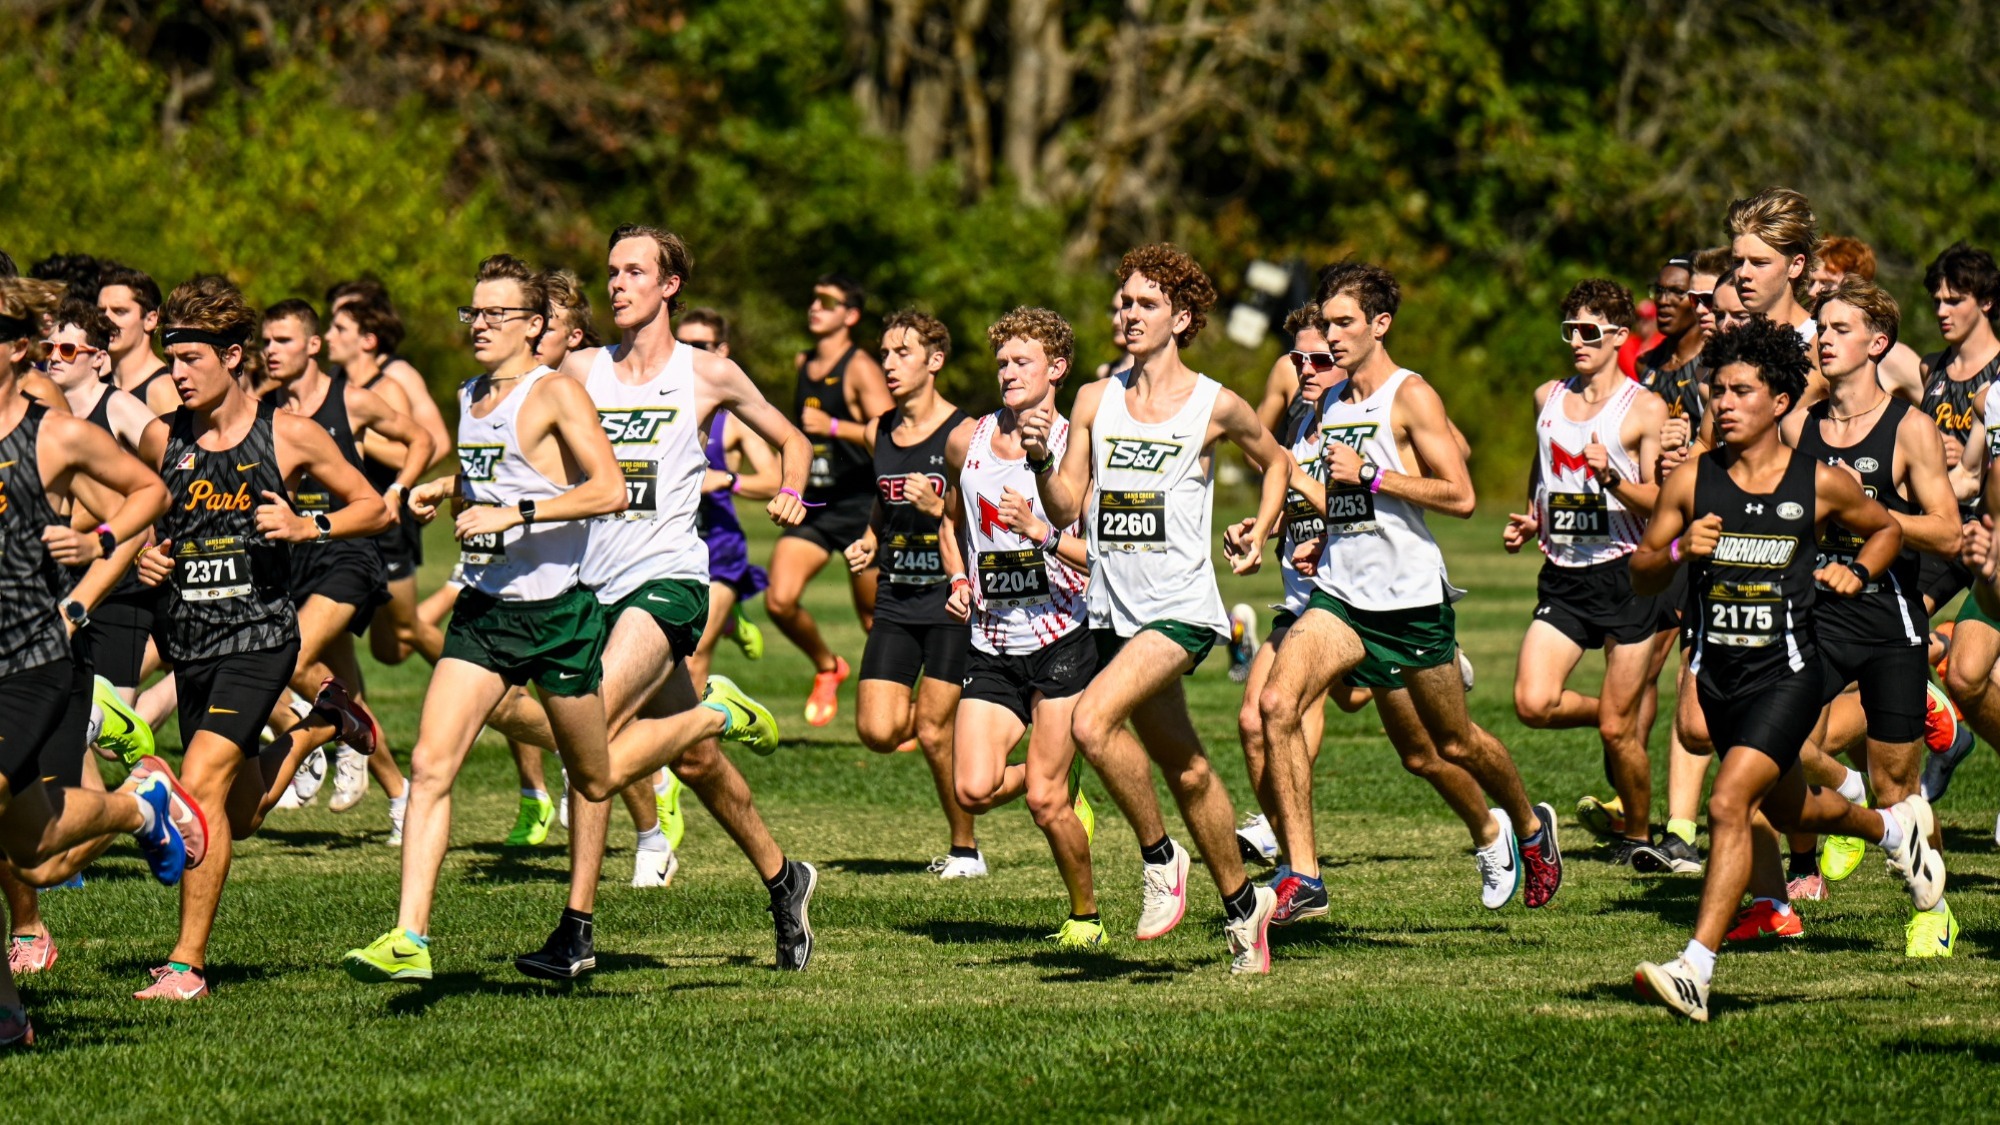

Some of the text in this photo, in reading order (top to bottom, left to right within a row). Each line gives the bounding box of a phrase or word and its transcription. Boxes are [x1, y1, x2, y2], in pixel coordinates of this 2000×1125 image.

[599, 410, 674, 442] S&T
[1936, 402, 1972, 430] Park
[1108, 439, 1179, 470] S&T
[184, 479, 252, 511] Park
[1328, 494, 1367, 518] 2253
[1102, 512, 1157, 536] 2260
[1290, 518, 1325, 543] 2259
[1554, 510, 1598, 530] 2201
[893, 550, 940, 570] 2445
[1713, 536, 1796, 564] NDENWOOD
[184, 557, 237, 584] 2371
[985, 569, 1039, 594] 2204
[1712, 603, 1773, 630] 2175
